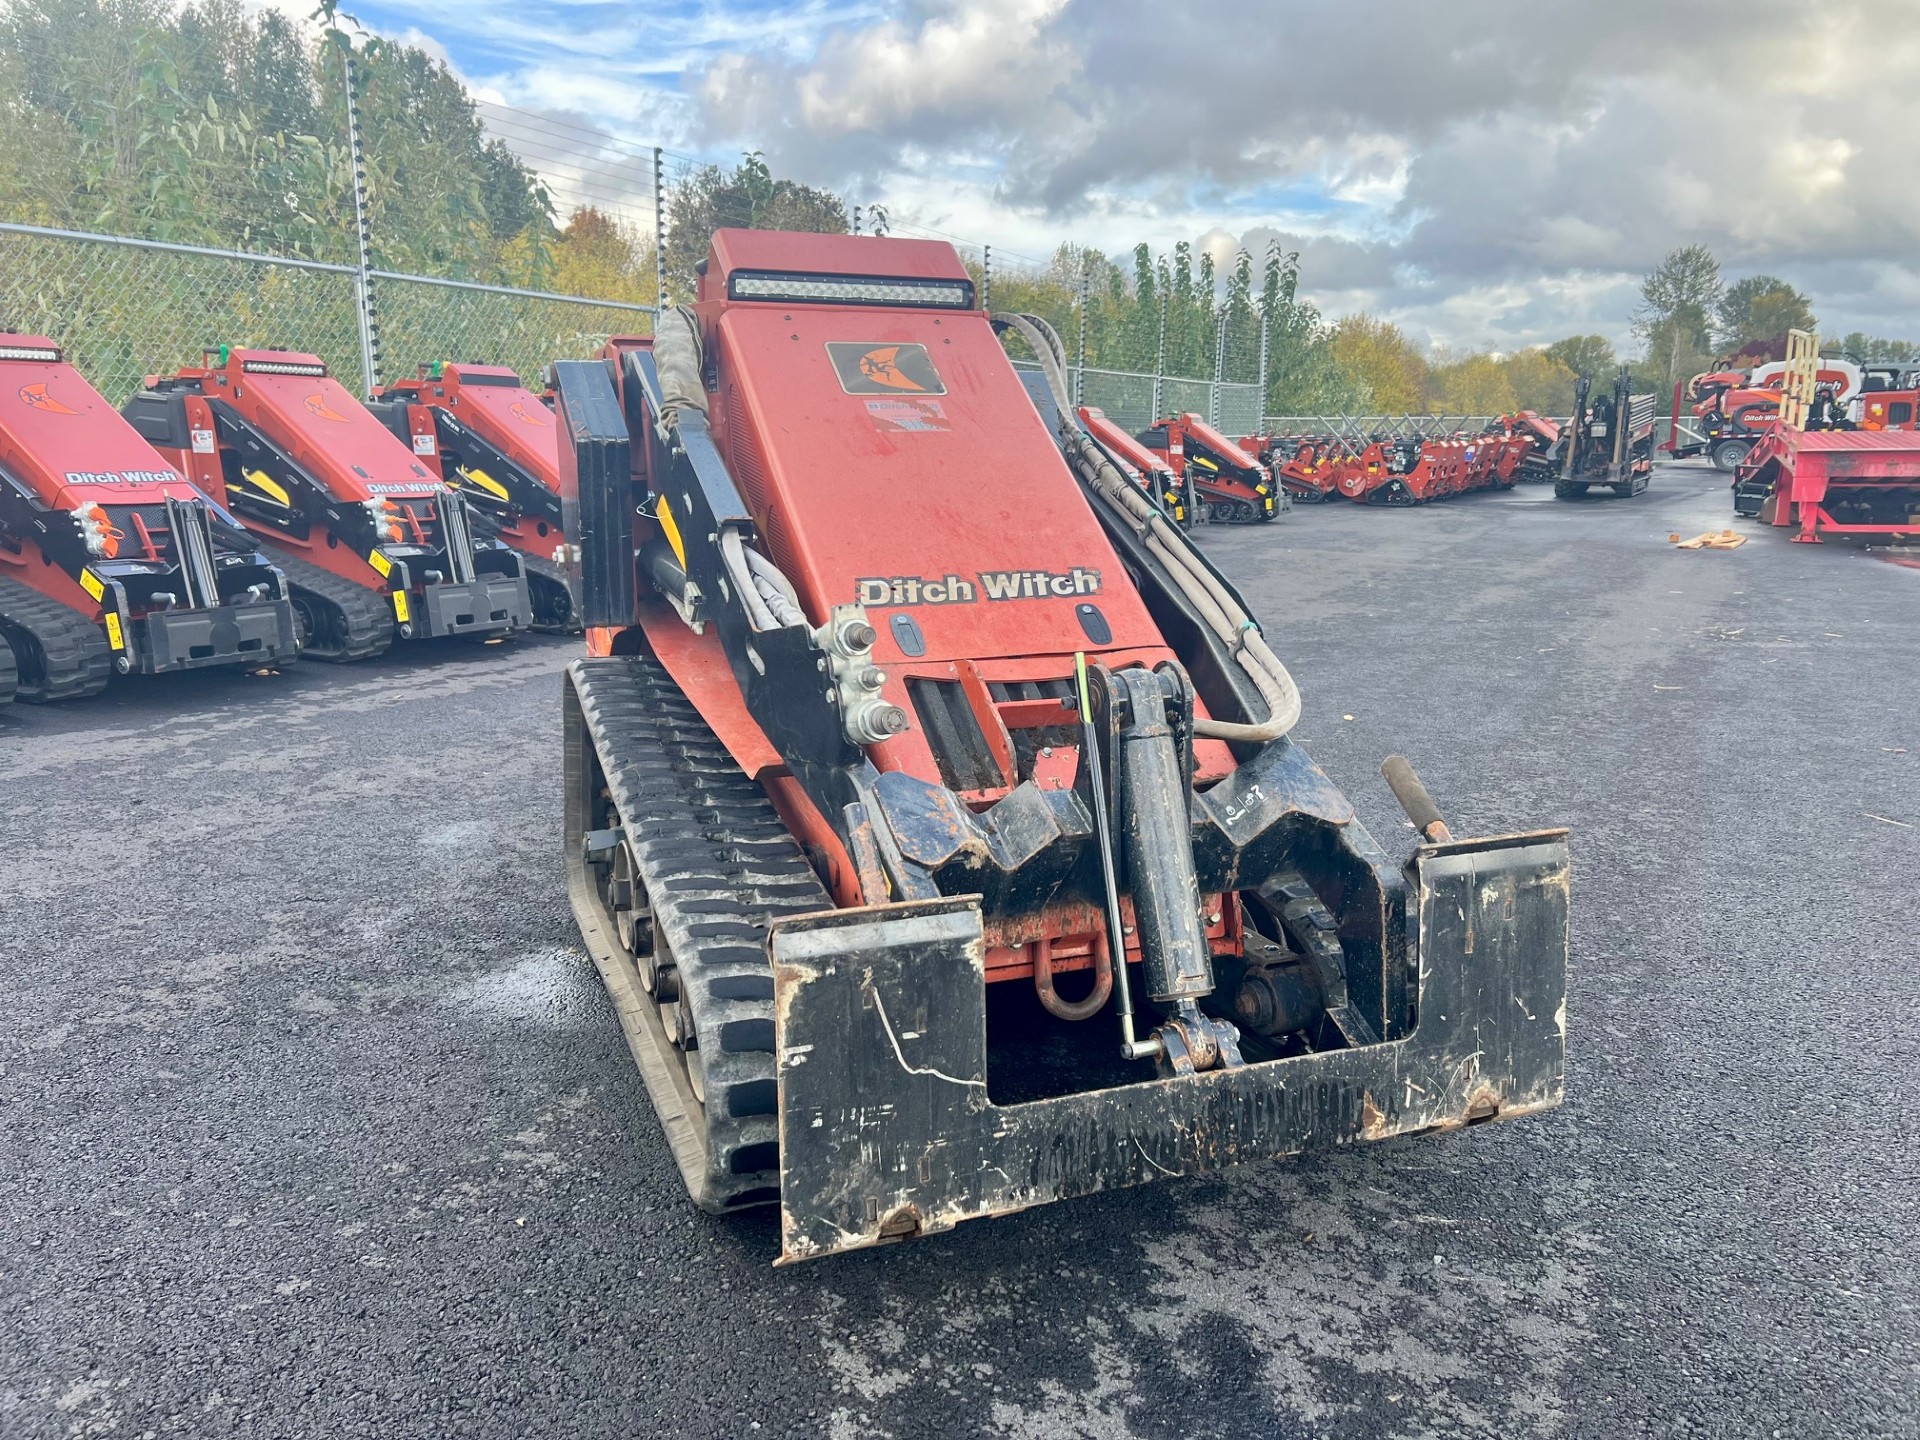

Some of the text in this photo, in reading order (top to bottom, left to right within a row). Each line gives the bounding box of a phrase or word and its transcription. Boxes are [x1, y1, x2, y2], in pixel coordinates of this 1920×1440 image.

[1744, 414, 1764, 422] Ditch
[65, 471, 177, 484] Ditch Witch
[366, 482, 446, 493] Ditch Witch
[860, 569, 1098, 605] Ditch Witch
